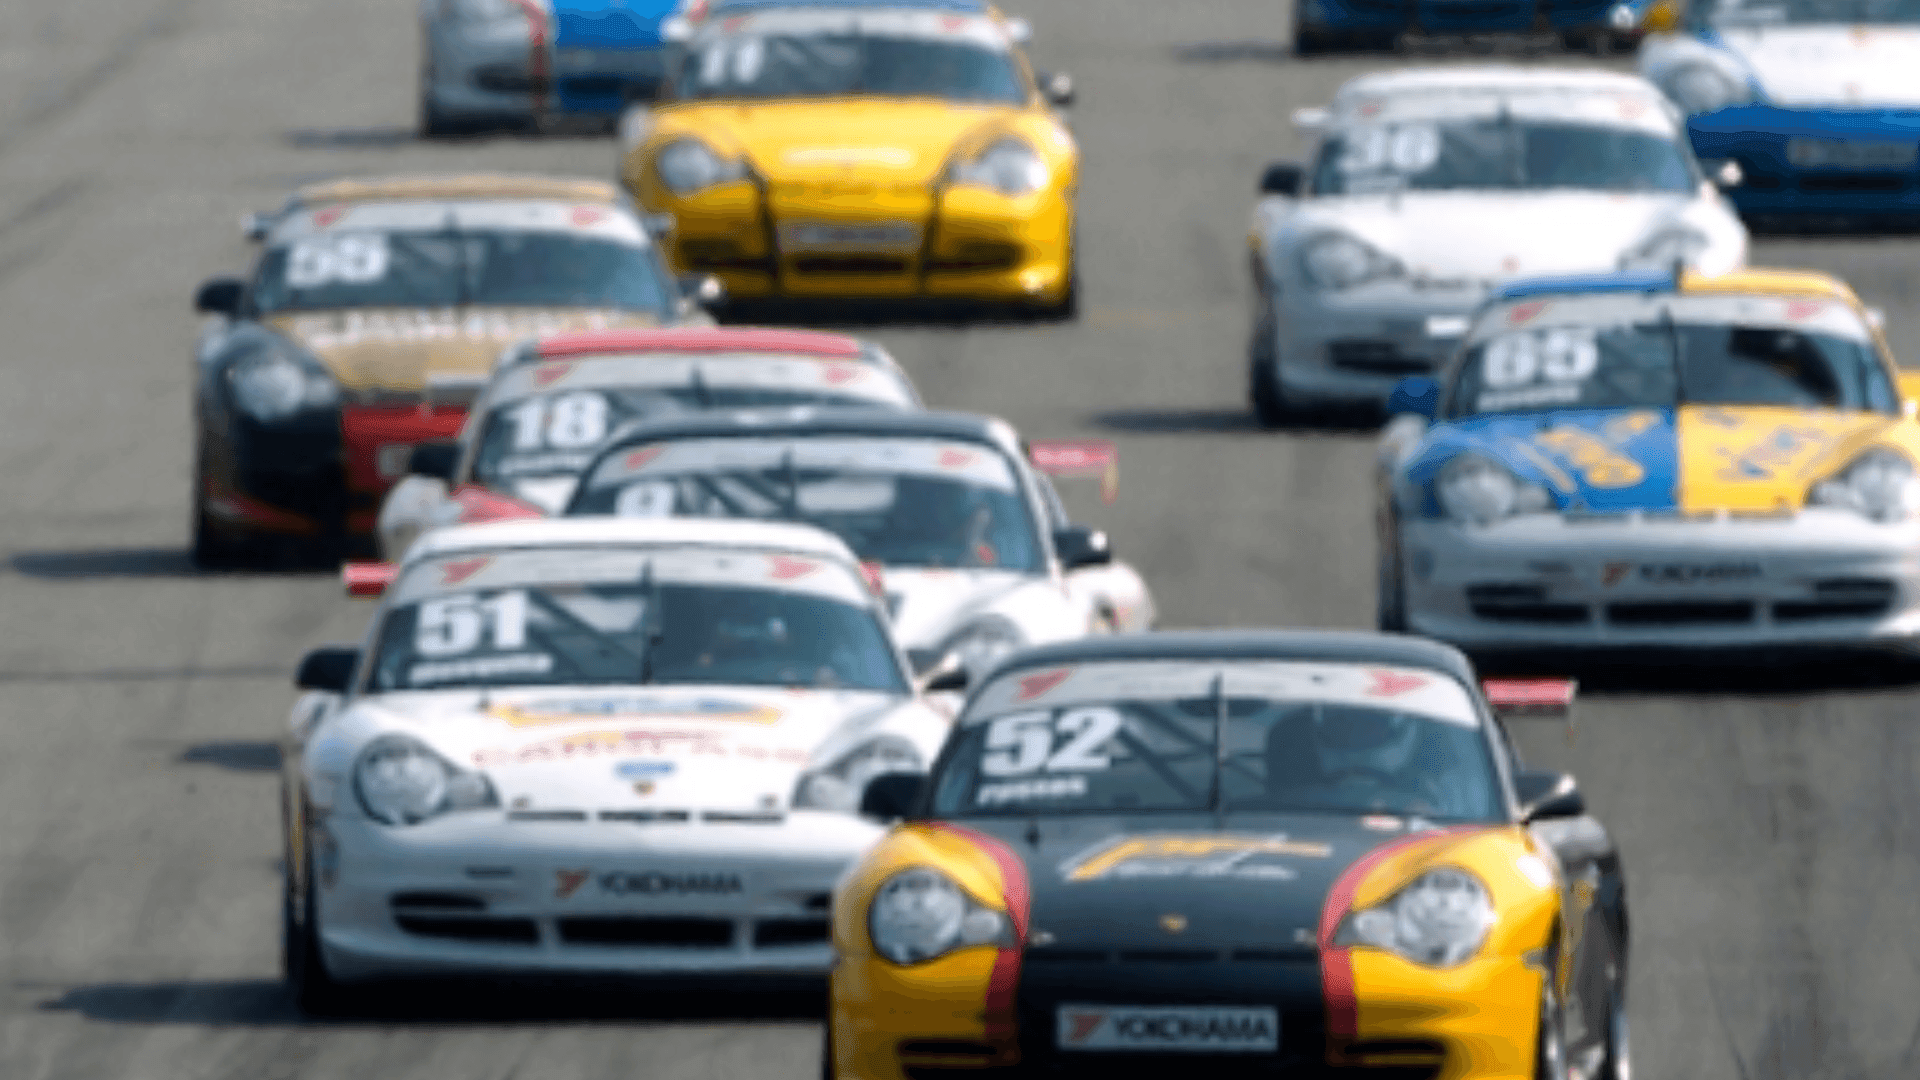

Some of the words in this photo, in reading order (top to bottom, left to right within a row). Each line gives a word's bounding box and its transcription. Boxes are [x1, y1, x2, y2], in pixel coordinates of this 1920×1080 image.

[508, 392, 607, 448] 18
[416, 590, 528, 656] 51
[980, 707, 1122, 776] 52
[600, 870, 744, 896] YOKOHAMA
[1113, 1017, 1272, 1043] YOKOHAMA
